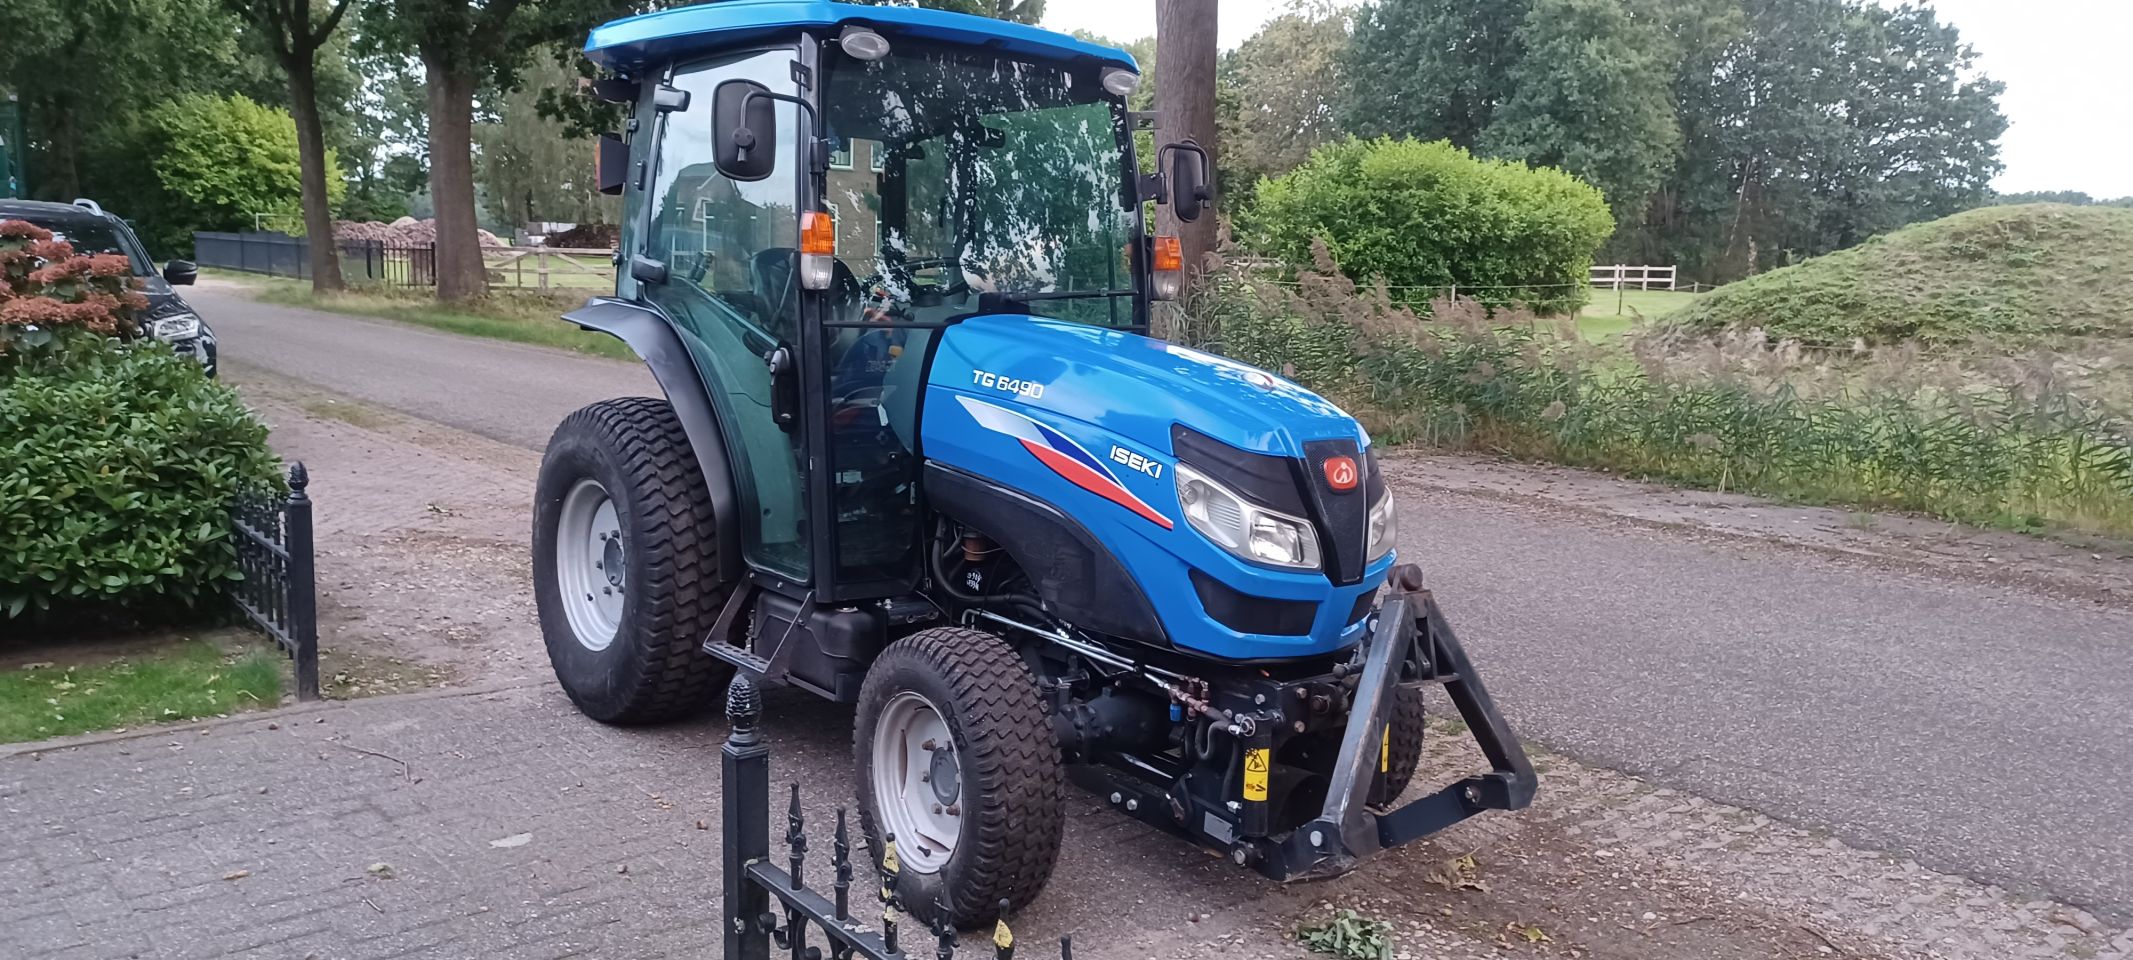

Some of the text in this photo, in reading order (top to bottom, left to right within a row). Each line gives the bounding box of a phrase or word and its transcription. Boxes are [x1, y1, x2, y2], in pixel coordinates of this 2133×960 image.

[973, 369, 1045, 399] TG 6490
[1109, 444, 1163, 479] ISEKI
